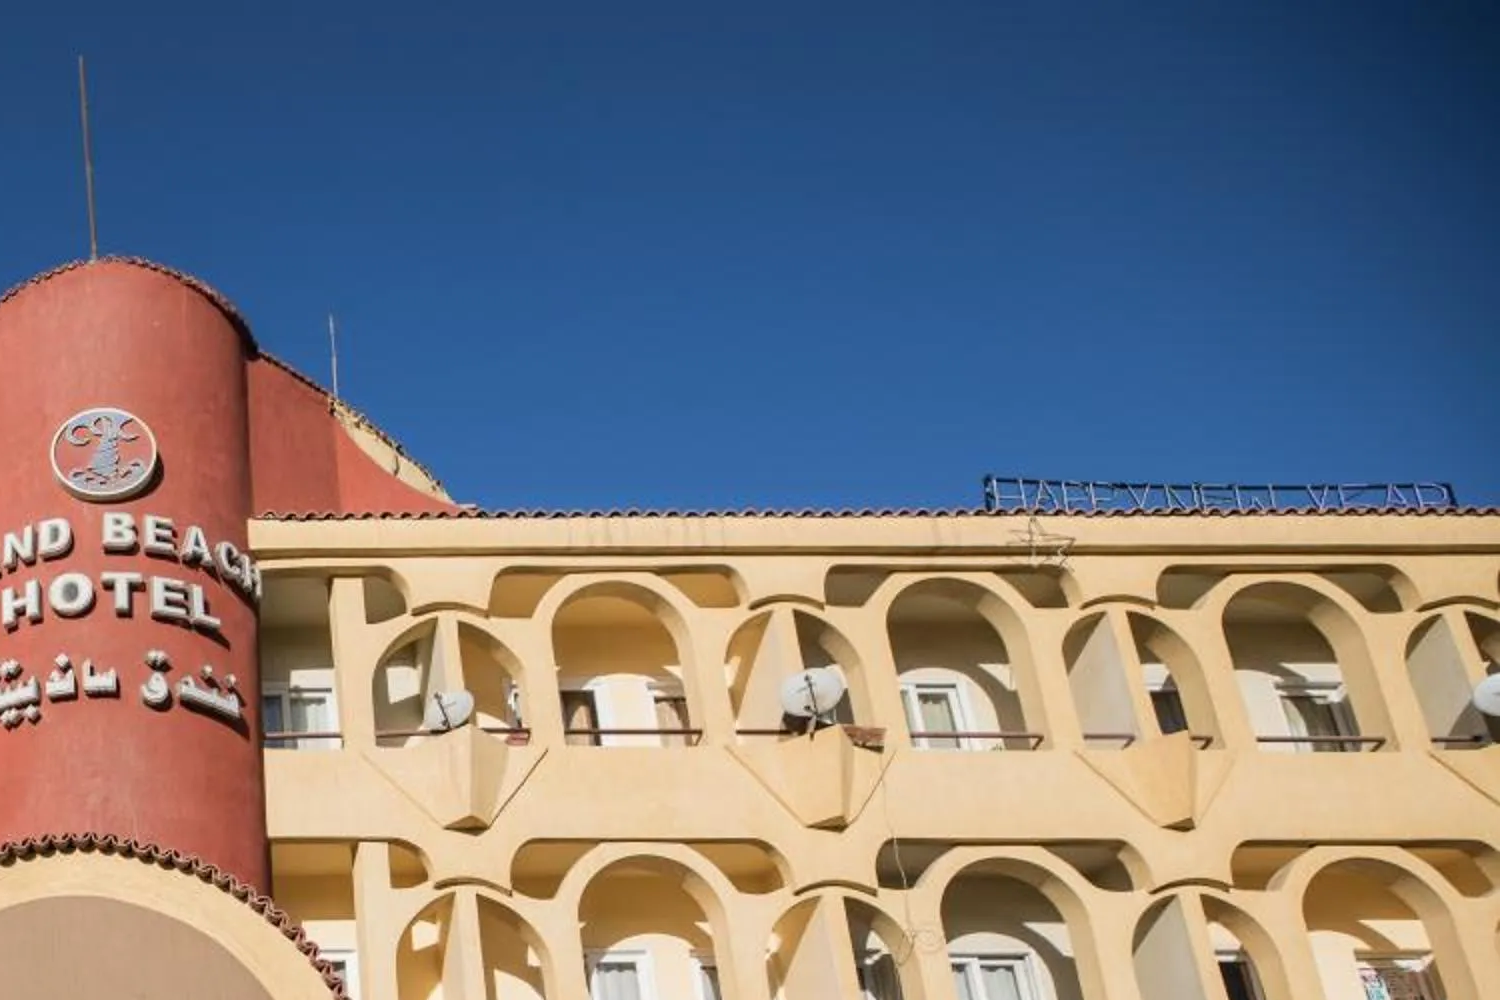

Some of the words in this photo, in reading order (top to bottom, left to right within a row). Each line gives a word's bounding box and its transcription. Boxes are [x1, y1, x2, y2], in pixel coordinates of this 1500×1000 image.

[102, 511, 263, 599] BEACH
[0, 572, 222, 629] HOTEL
[46, 653, 118, 700] ساند
[141, 648, 241, 720] فندق
